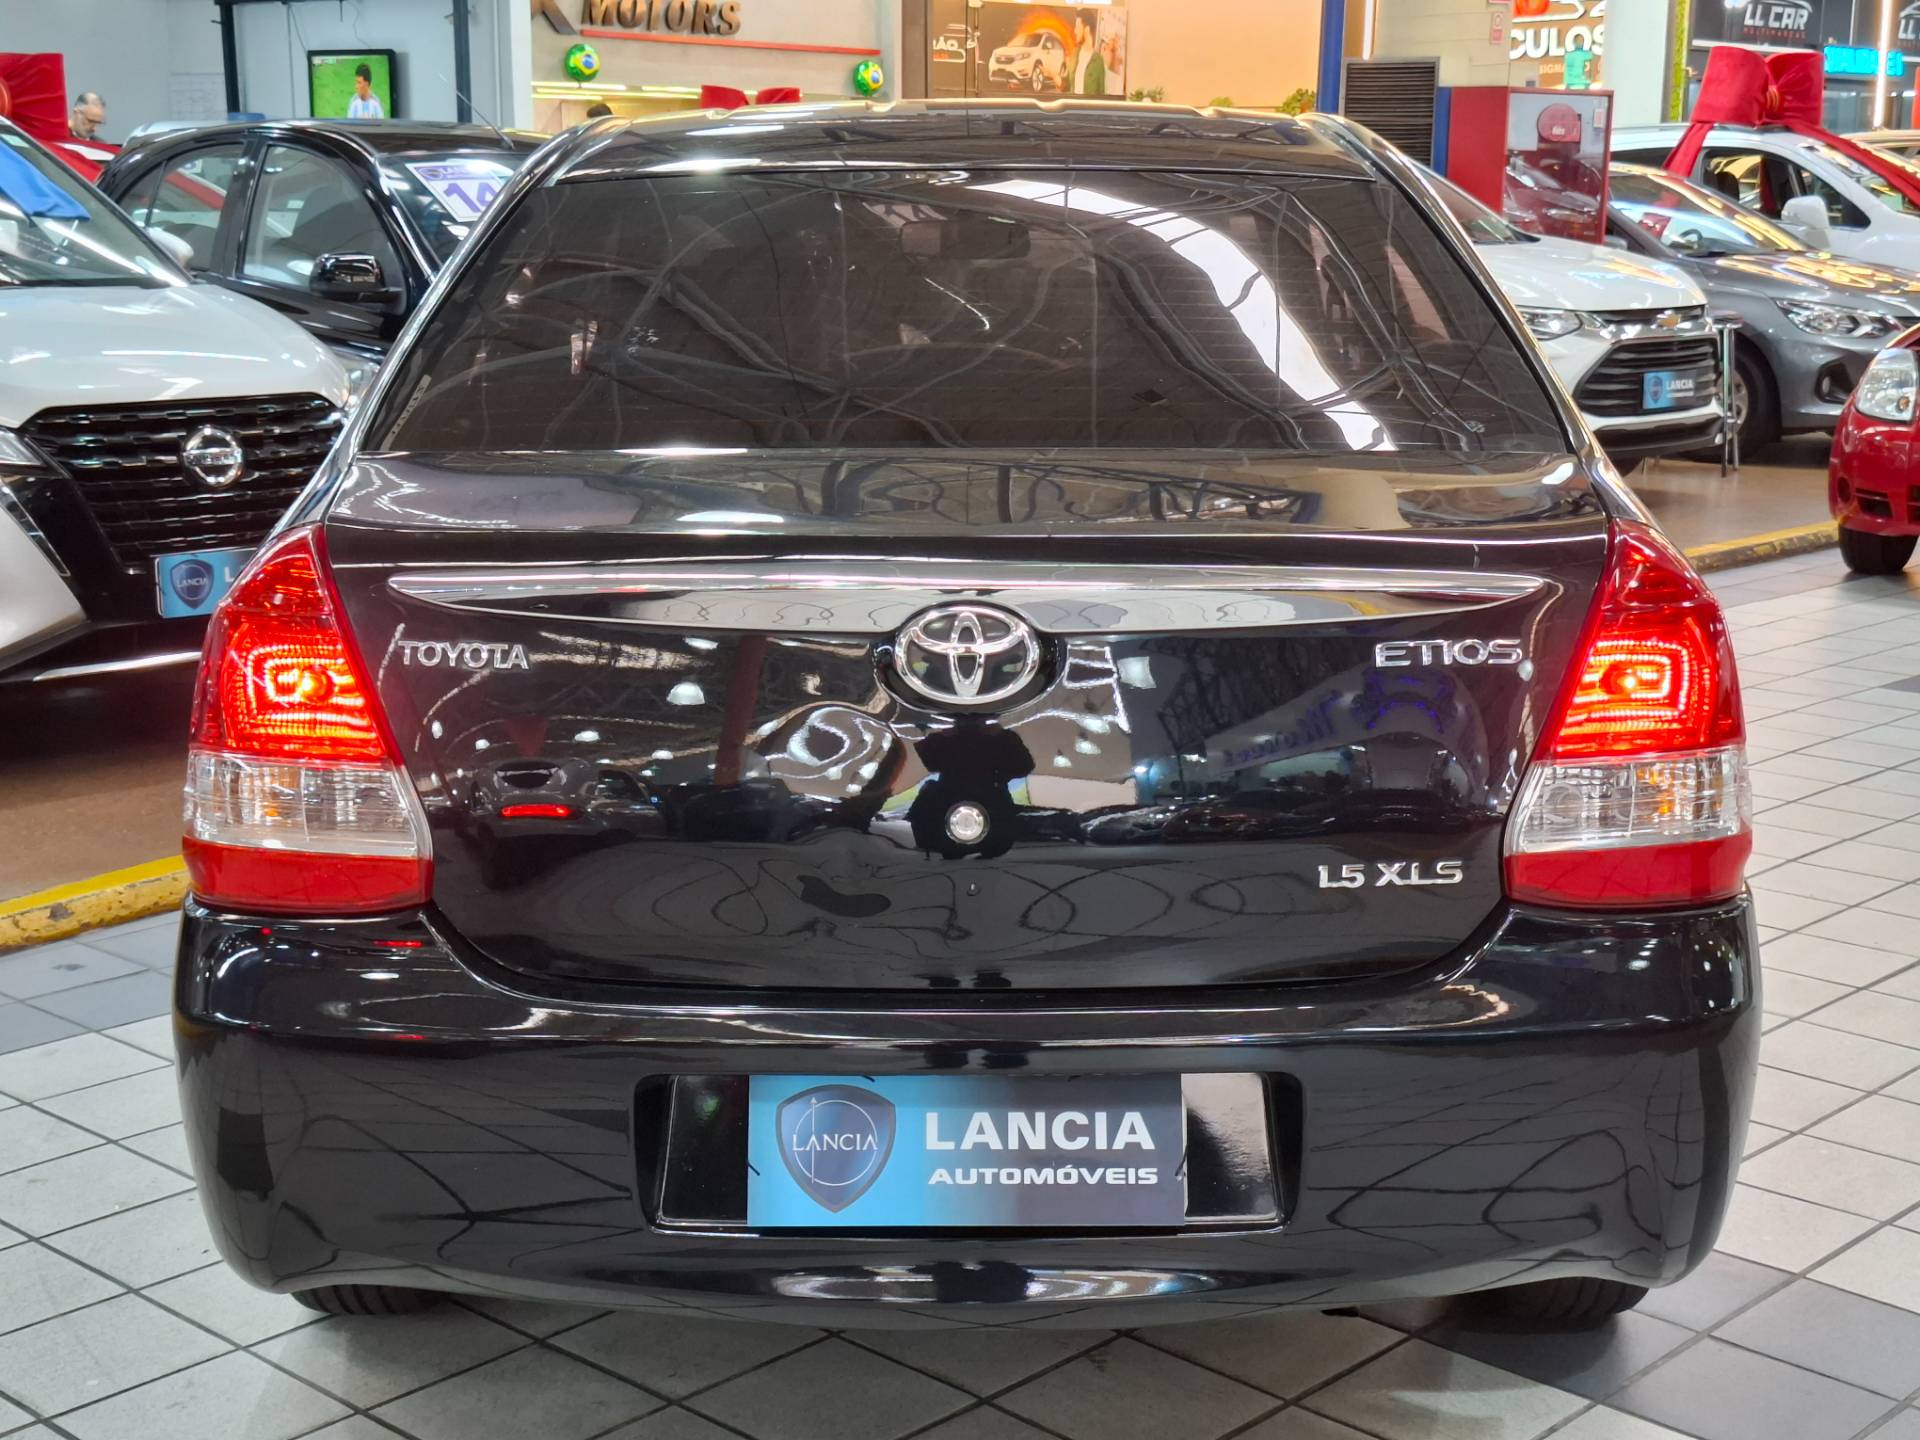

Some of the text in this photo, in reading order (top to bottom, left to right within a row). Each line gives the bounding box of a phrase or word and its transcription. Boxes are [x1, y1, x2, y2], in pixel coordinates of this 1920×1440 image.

[582, 0, 742, 35] MOTORS
[1744, 4, 1809, 30] LL CAR
[398, 640, 529, 670] TOYOTA
[1375, 638, 1523, 668] ETIOS
[1375, 860, 1464, 887] XLS
[792, 1133, 878, 1151] LANCIA
[925, 1111, 1156, 1150] LANCIA
[928, 1164, 1158, 1185] AUTOMÓVEIS
